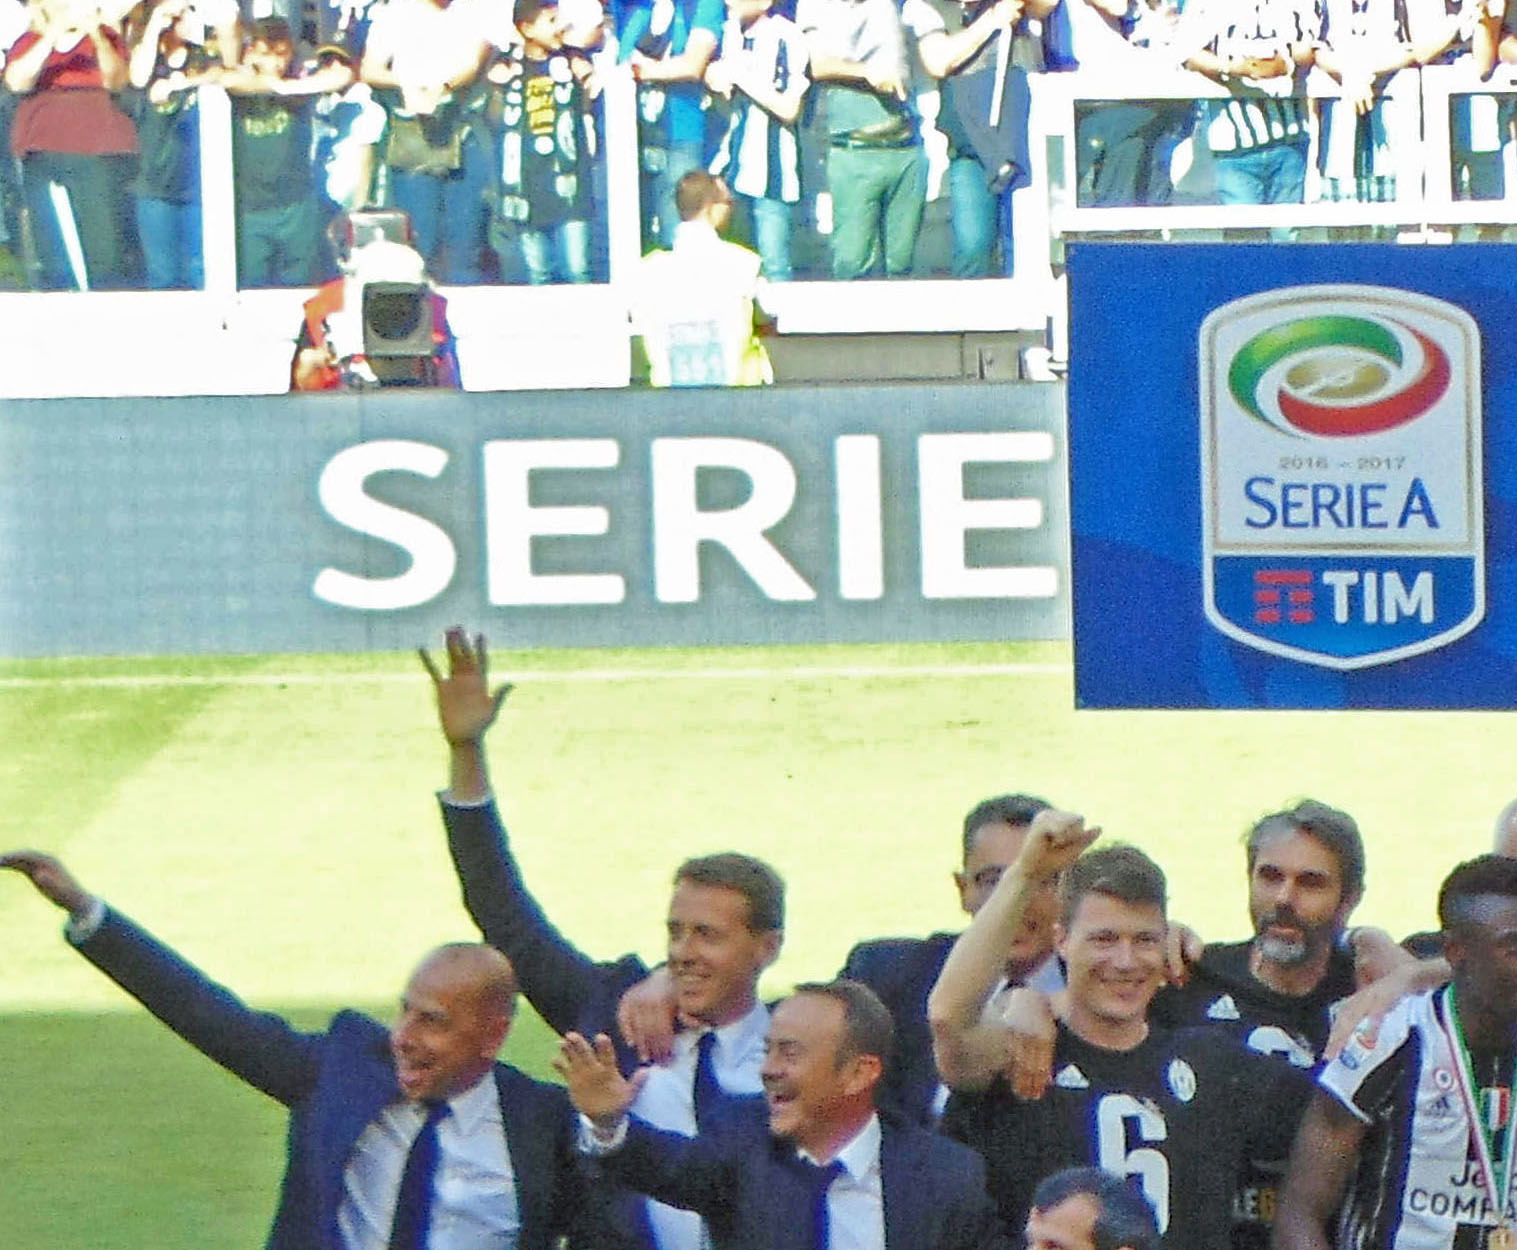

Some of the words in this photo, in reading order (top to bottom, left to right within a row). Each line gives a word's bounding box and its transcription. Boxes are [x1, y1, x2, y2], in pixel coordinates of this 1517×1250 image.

[1357, 456, 1407, 470] 2017
[313, 431, 1058, 610] SERIE
[1244, 475, 1388, 530] SERIE
[1397, 477, 1441, 530] A
[1322, 571, 1435, 624] TIM
